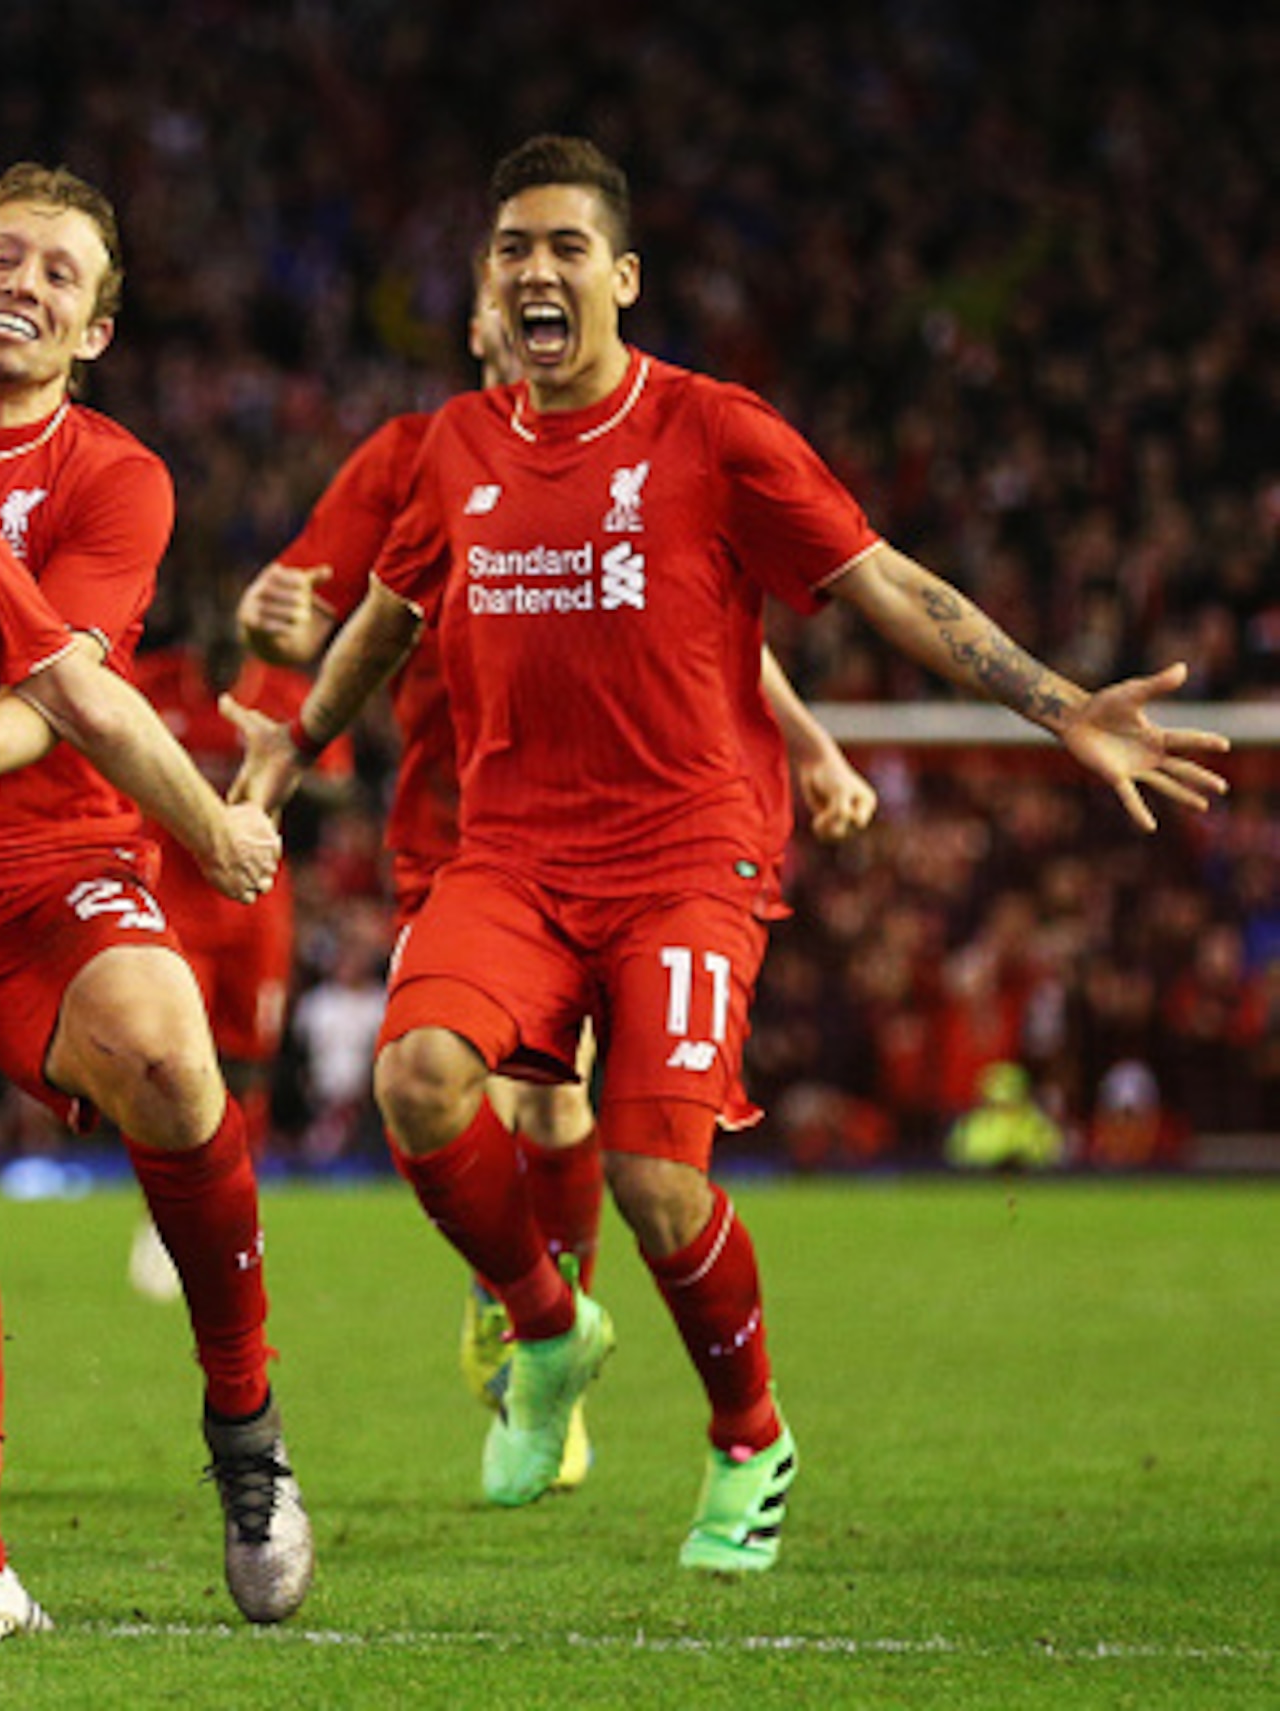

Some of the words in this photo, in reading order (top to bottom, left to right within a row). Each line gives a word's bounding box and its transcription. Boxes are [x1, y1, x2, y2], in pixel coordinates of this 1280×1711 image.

[468, 541, 593, 579] Standard
[468, 580, 594, 615] Chartered
[660, 946, 731, 1043] 11
